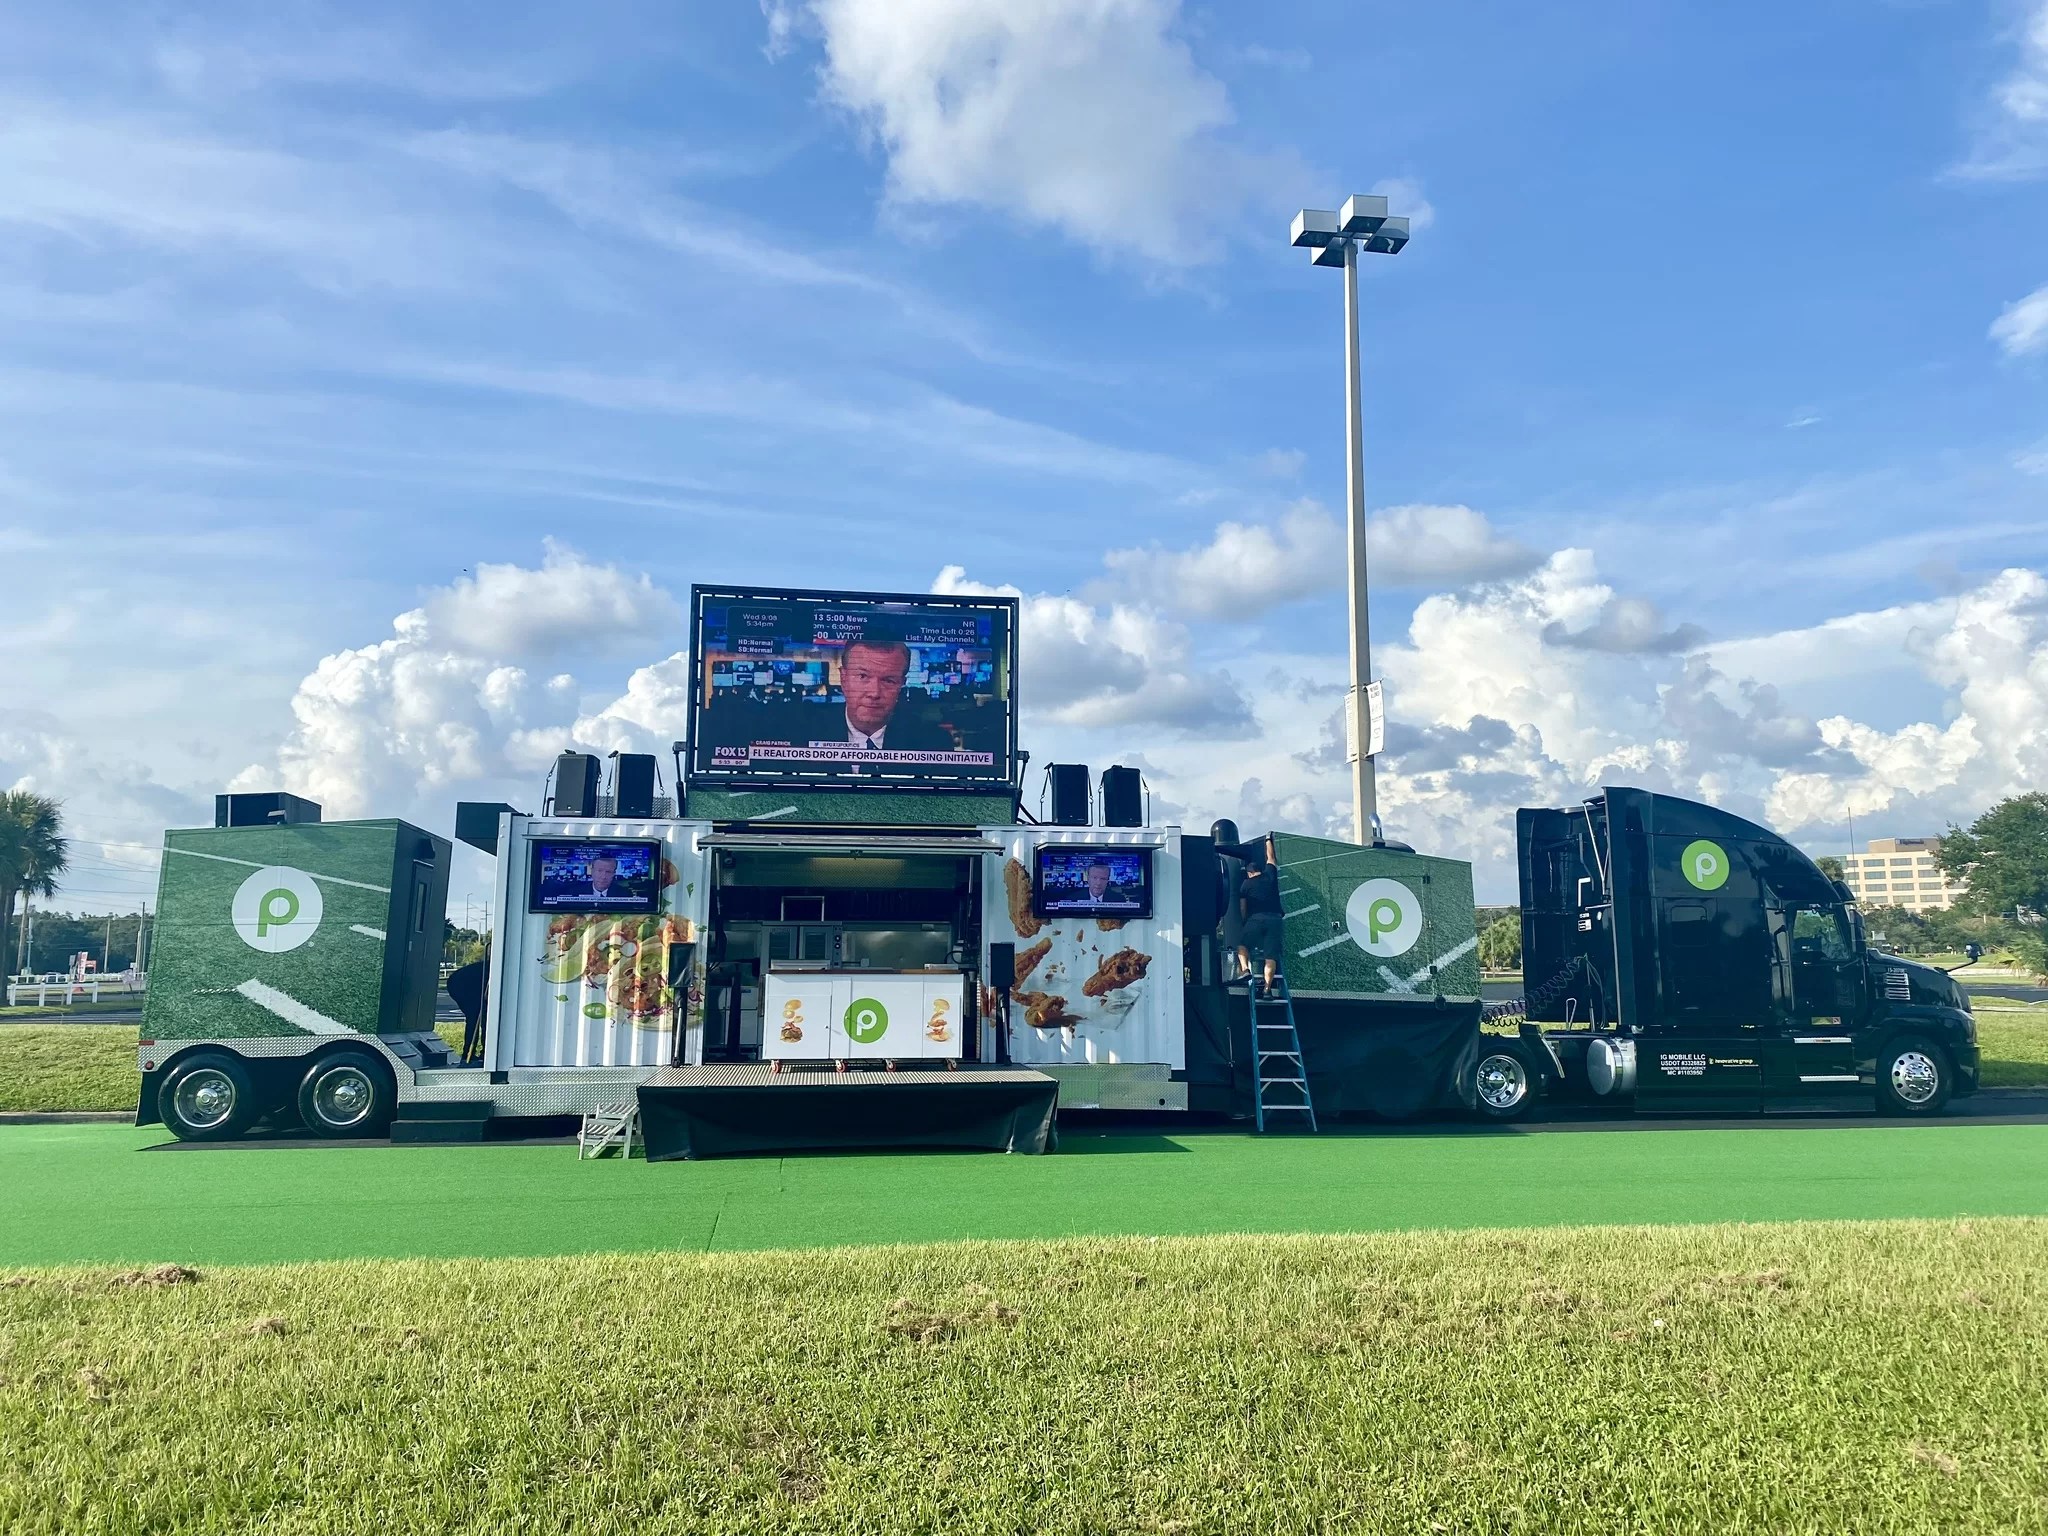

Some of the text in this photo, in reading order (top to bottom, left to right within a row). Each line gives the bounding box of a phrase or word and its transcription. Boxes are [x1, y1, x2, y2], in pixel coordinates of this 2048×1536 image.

[826, 614, 844, 622] 5:00
[846, 615, 868, 623] News
[832, 623, 862, 631] 6:00pm
[836, 632, 864, 640] WTVT
[924, 635, 936, 643] My
[938, 636, 975, 644] Channels
[715, 746, 746, 757] FOX 13
[753, 749, 990, 763] FL REALTORS DROP AFFORDABLE HOUSING INITIATIVE
